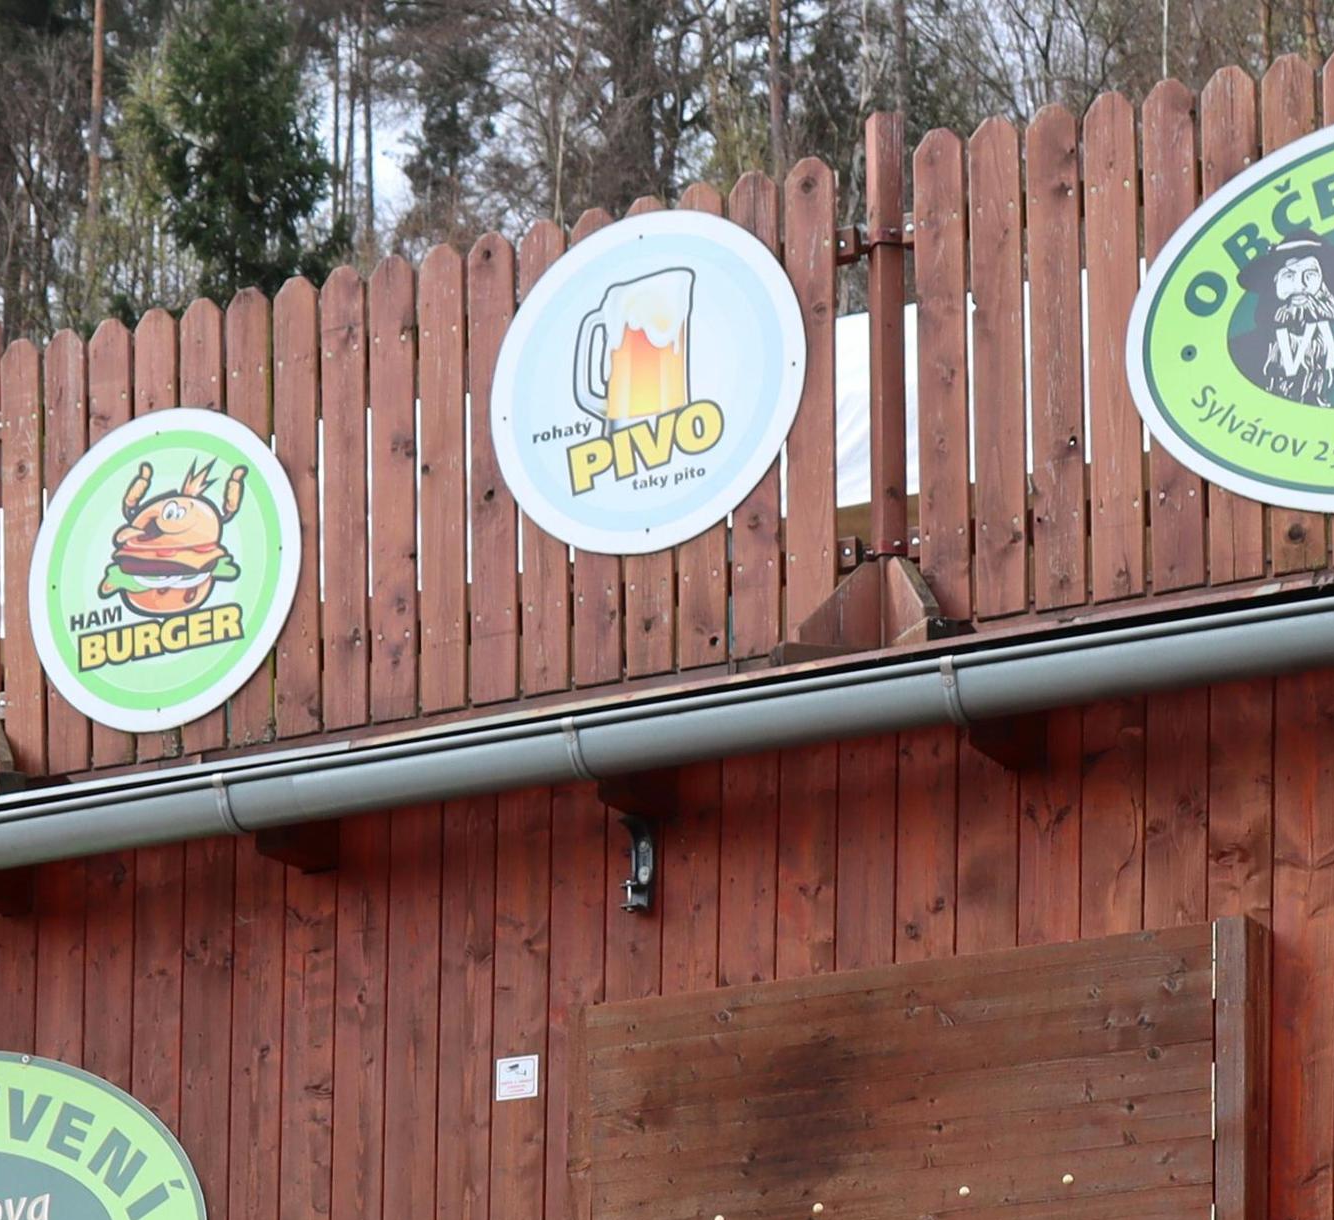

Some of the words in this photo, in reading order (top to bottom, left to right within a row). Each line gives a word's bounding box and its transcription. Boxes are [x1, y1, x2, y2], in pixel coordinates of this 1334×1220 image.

[532, 418, 592, 444] rohatý
[1191, 385, 1307, 457] Sylvárov
[567, 399, 724, 496] PIVO
[632, 472, 667, 491] taky
[70, 606, 122, 631] HAM
[78, 603, 245, 672] BURGER
